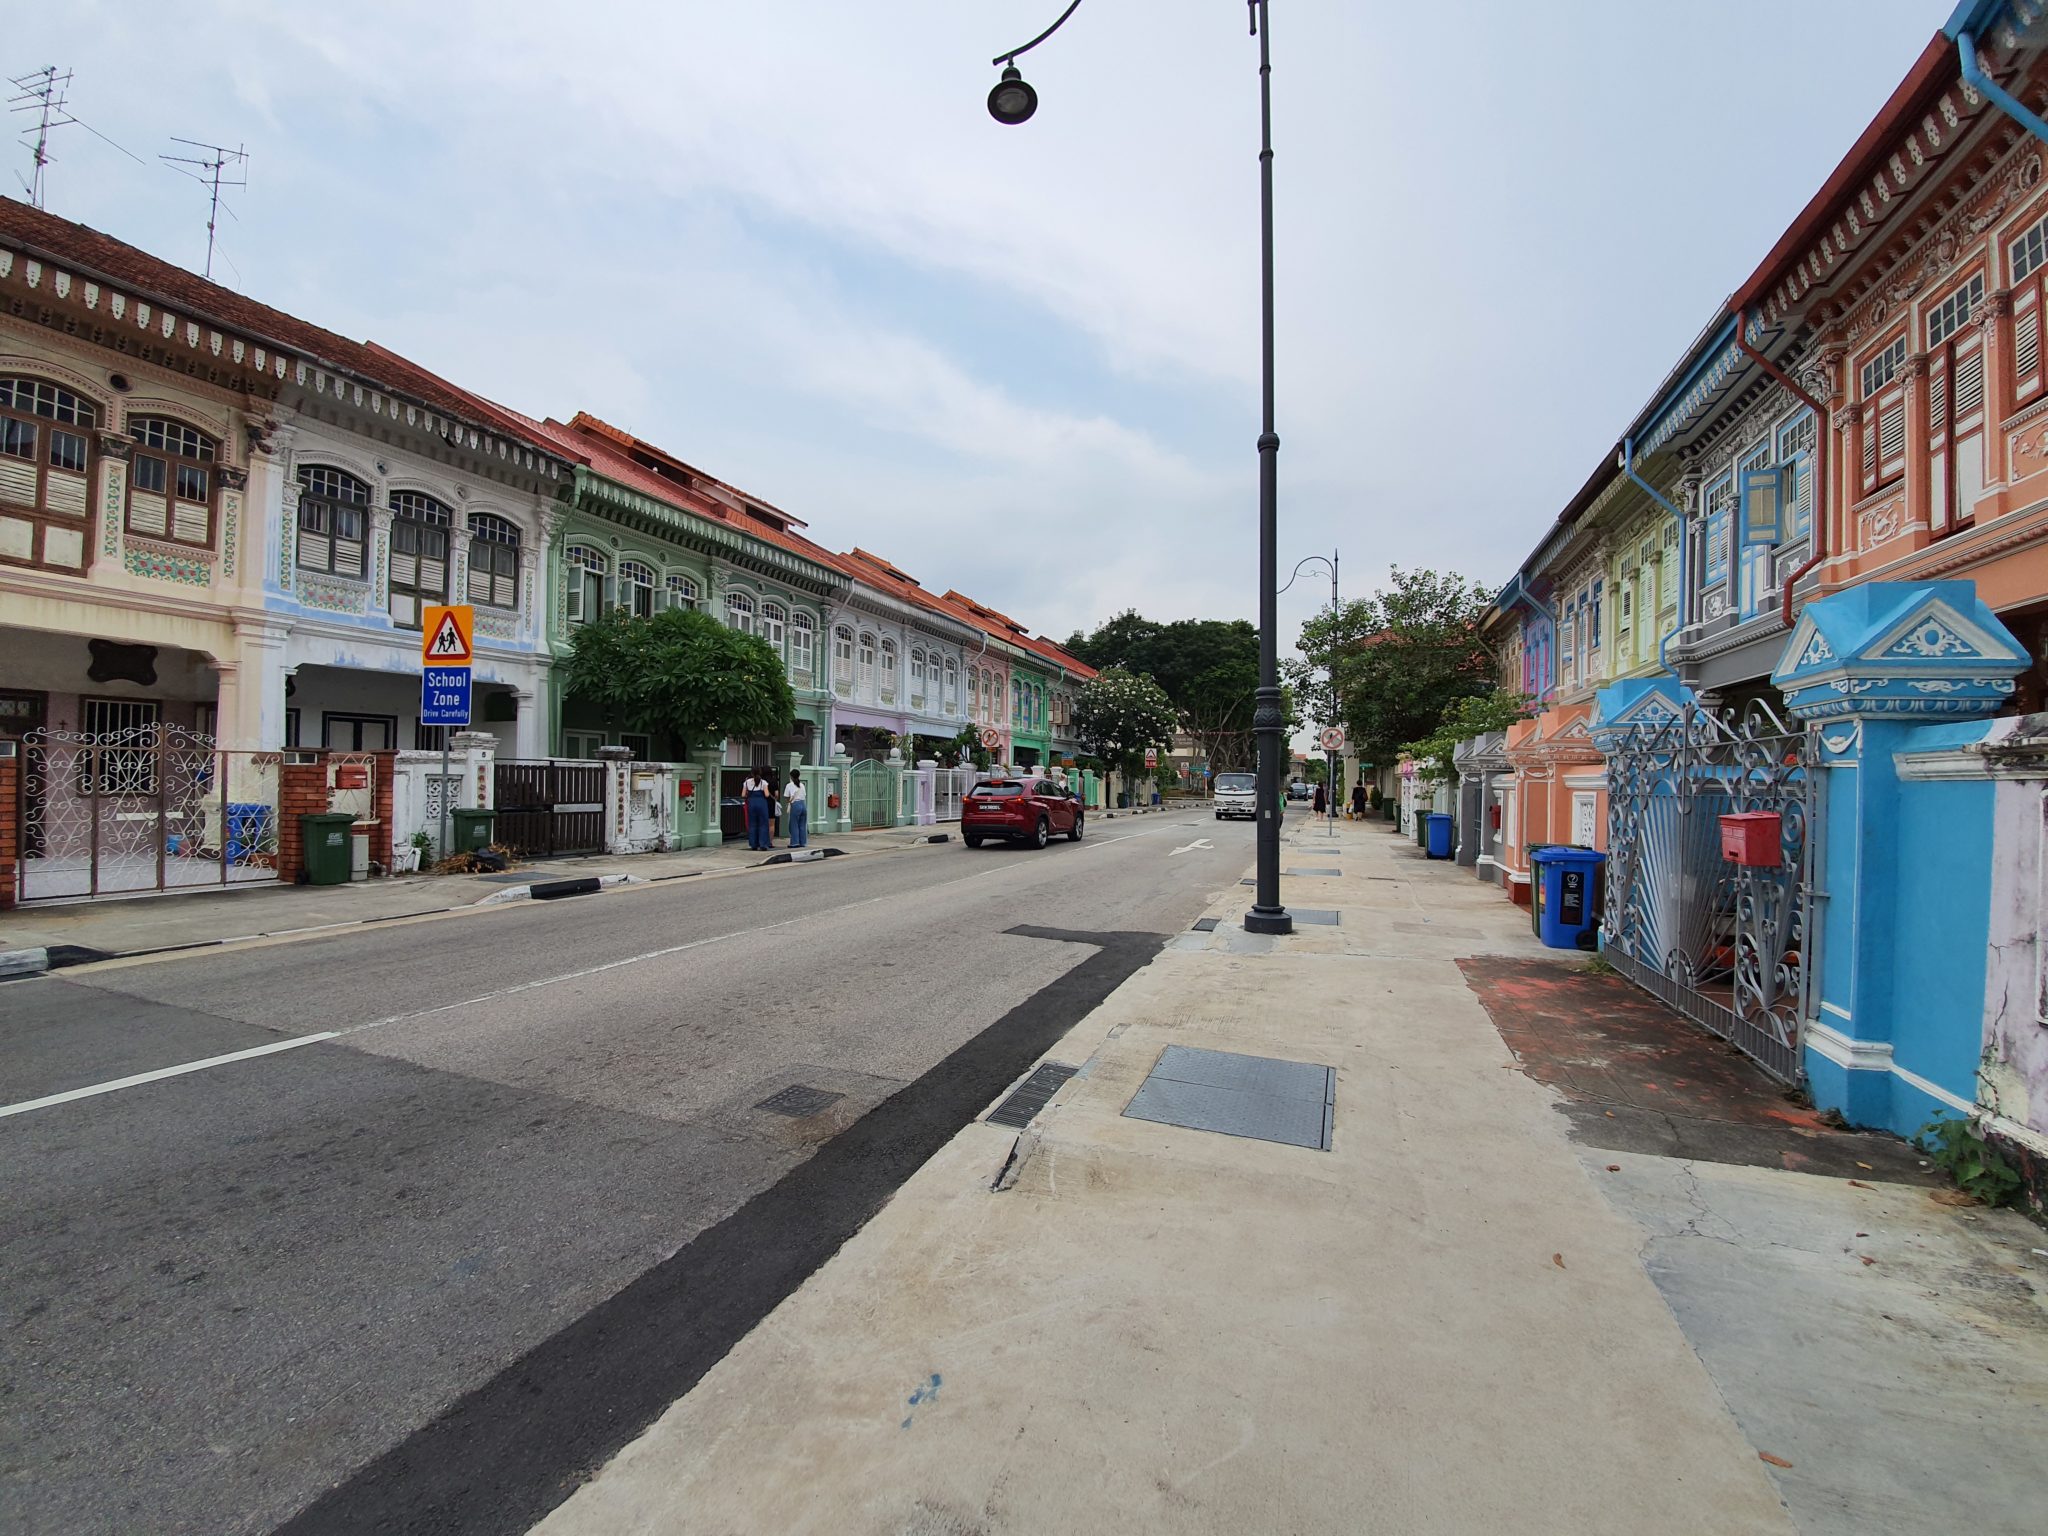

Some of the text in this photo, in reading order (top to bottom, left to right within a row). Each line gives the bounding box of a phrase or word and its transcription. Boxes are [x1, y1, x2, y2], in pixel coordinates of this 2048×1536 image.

[428, 672, 466, 687] School
[433, 691, 460, 706] Zone
[423, 709, 468, 719] Drive Carefully
